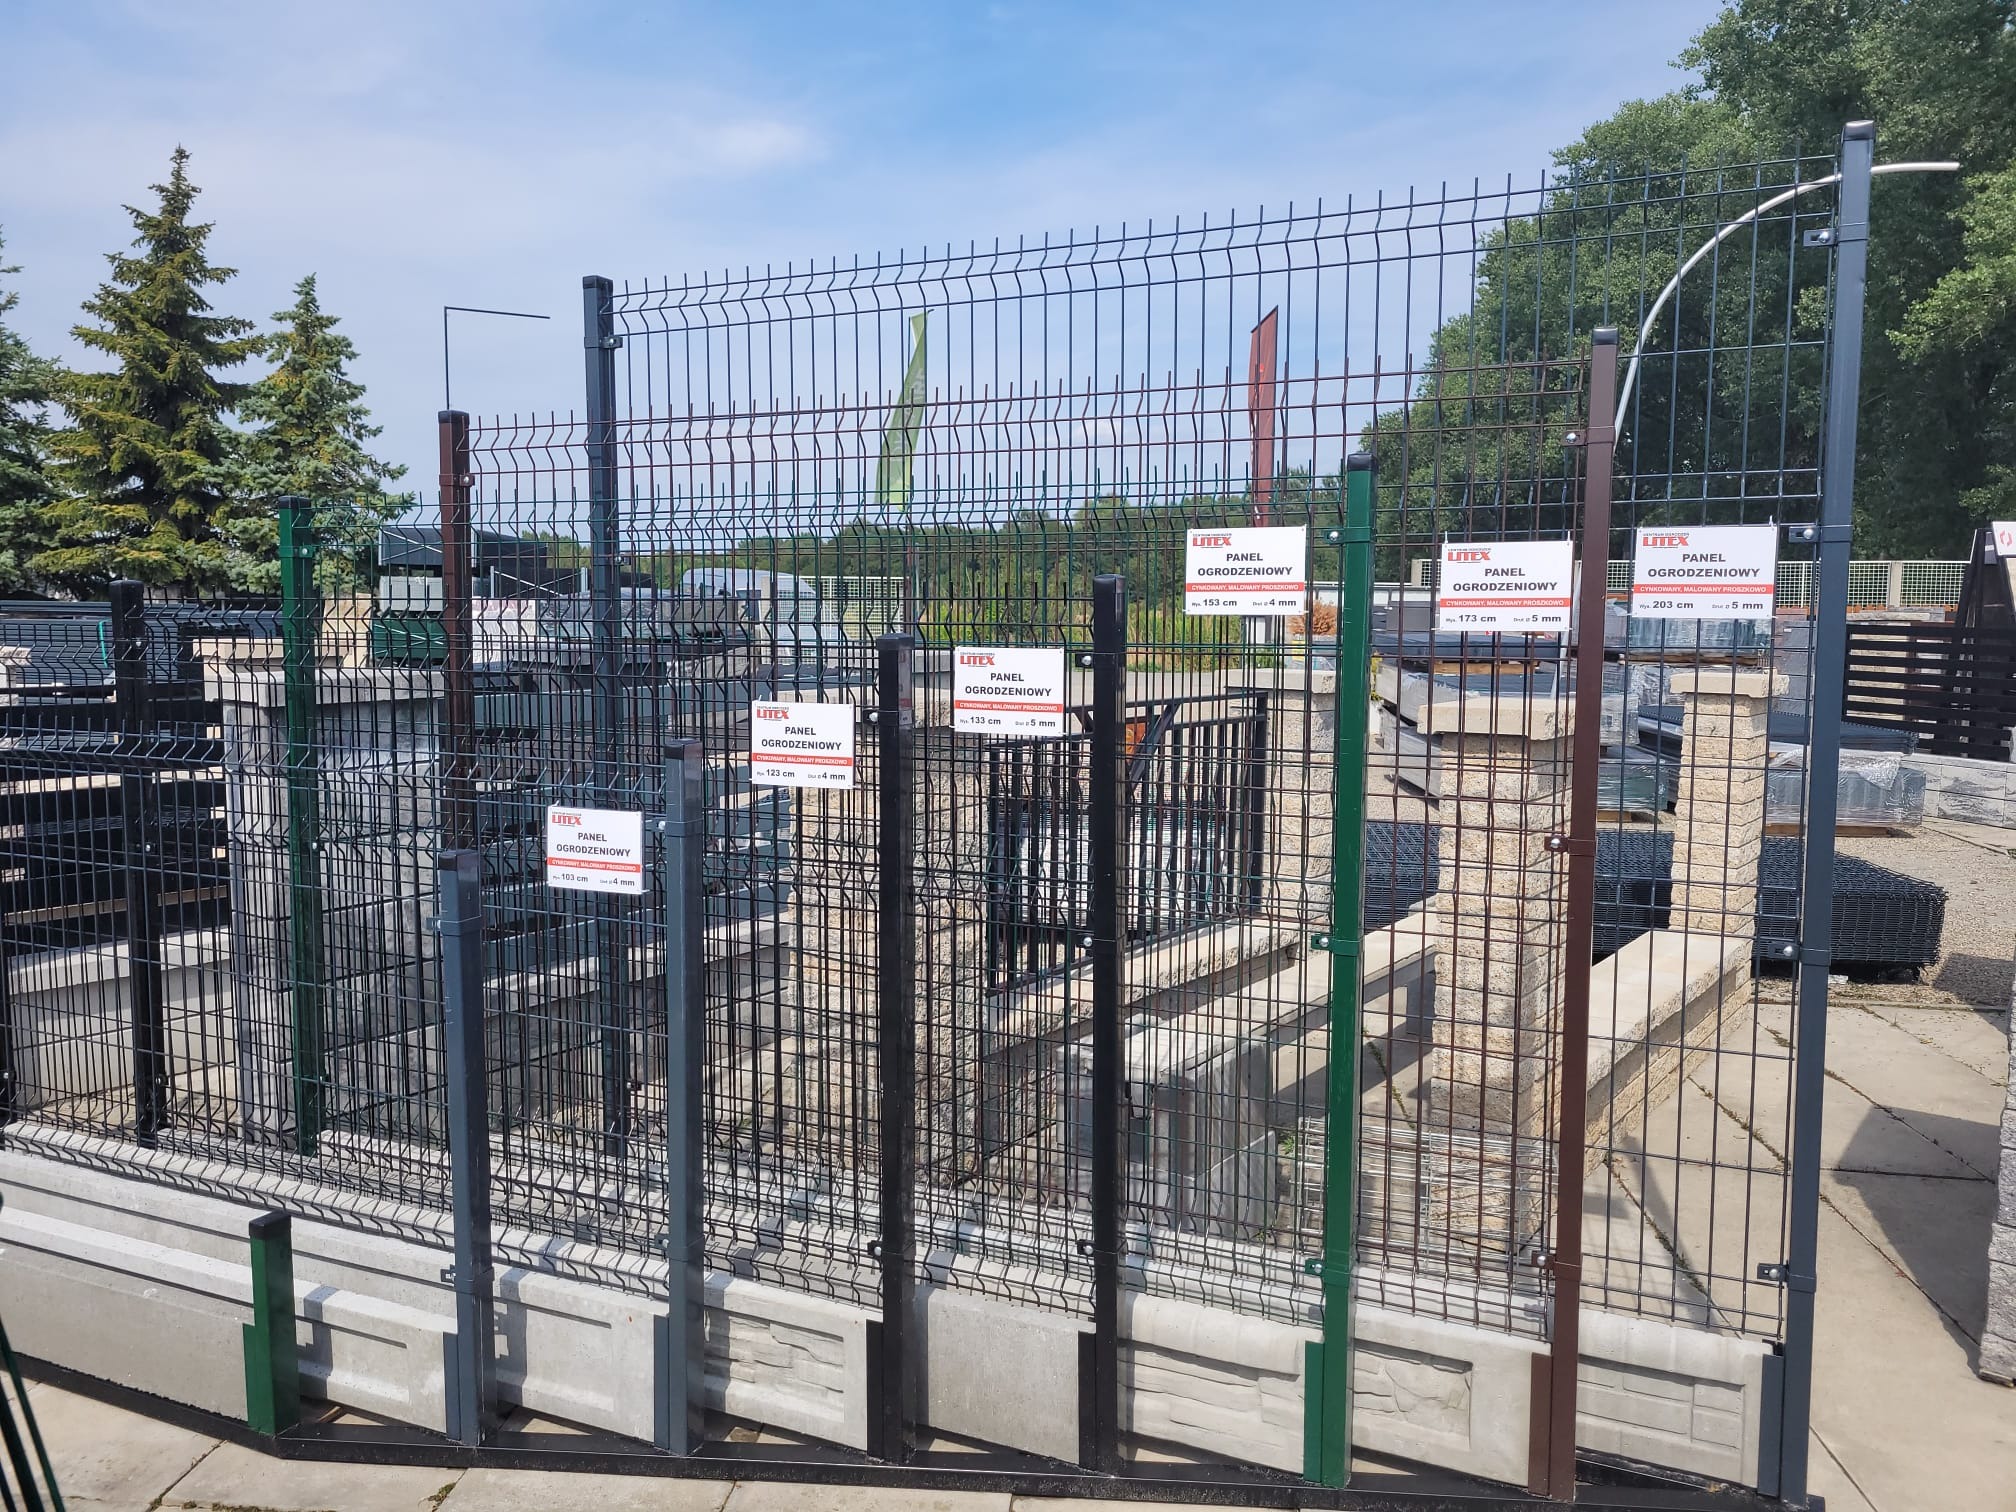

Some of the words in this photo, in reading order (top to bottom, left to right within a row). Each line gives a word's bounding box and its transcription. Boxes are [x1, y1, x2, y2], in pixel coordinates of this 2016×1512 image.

[1193, 537, 1231, 546] LITEX
[1643, 537, 1689, 546] LITEX
[1227, 553, 1263, 561] PANEL
[1448, 552, 1491, 561] LITEX
[1682, 554, 1726, 562] PANEL
[1198, 567, 1293, 576] OGRODZENIOWY
[1485, 568, 1525, 576] PANEL
[1648, 568, 1760, 577] OGRODZENIOWY
[1453, 582, 1557, 591] OGRODZENIOWY
[1653, 601, 1672, 609] 203
[991, 673, 1024, 681] PANEL
[965, 686, 1051, 696] OGRODZENIOWY
[785, 726, 816, 735] PANEL
[762, 739, 841, 750] OGRODZENIOWY
[578, 833, 607, 842] PANEL
[556, 844, 630, 856] OGRODZENIOWY
